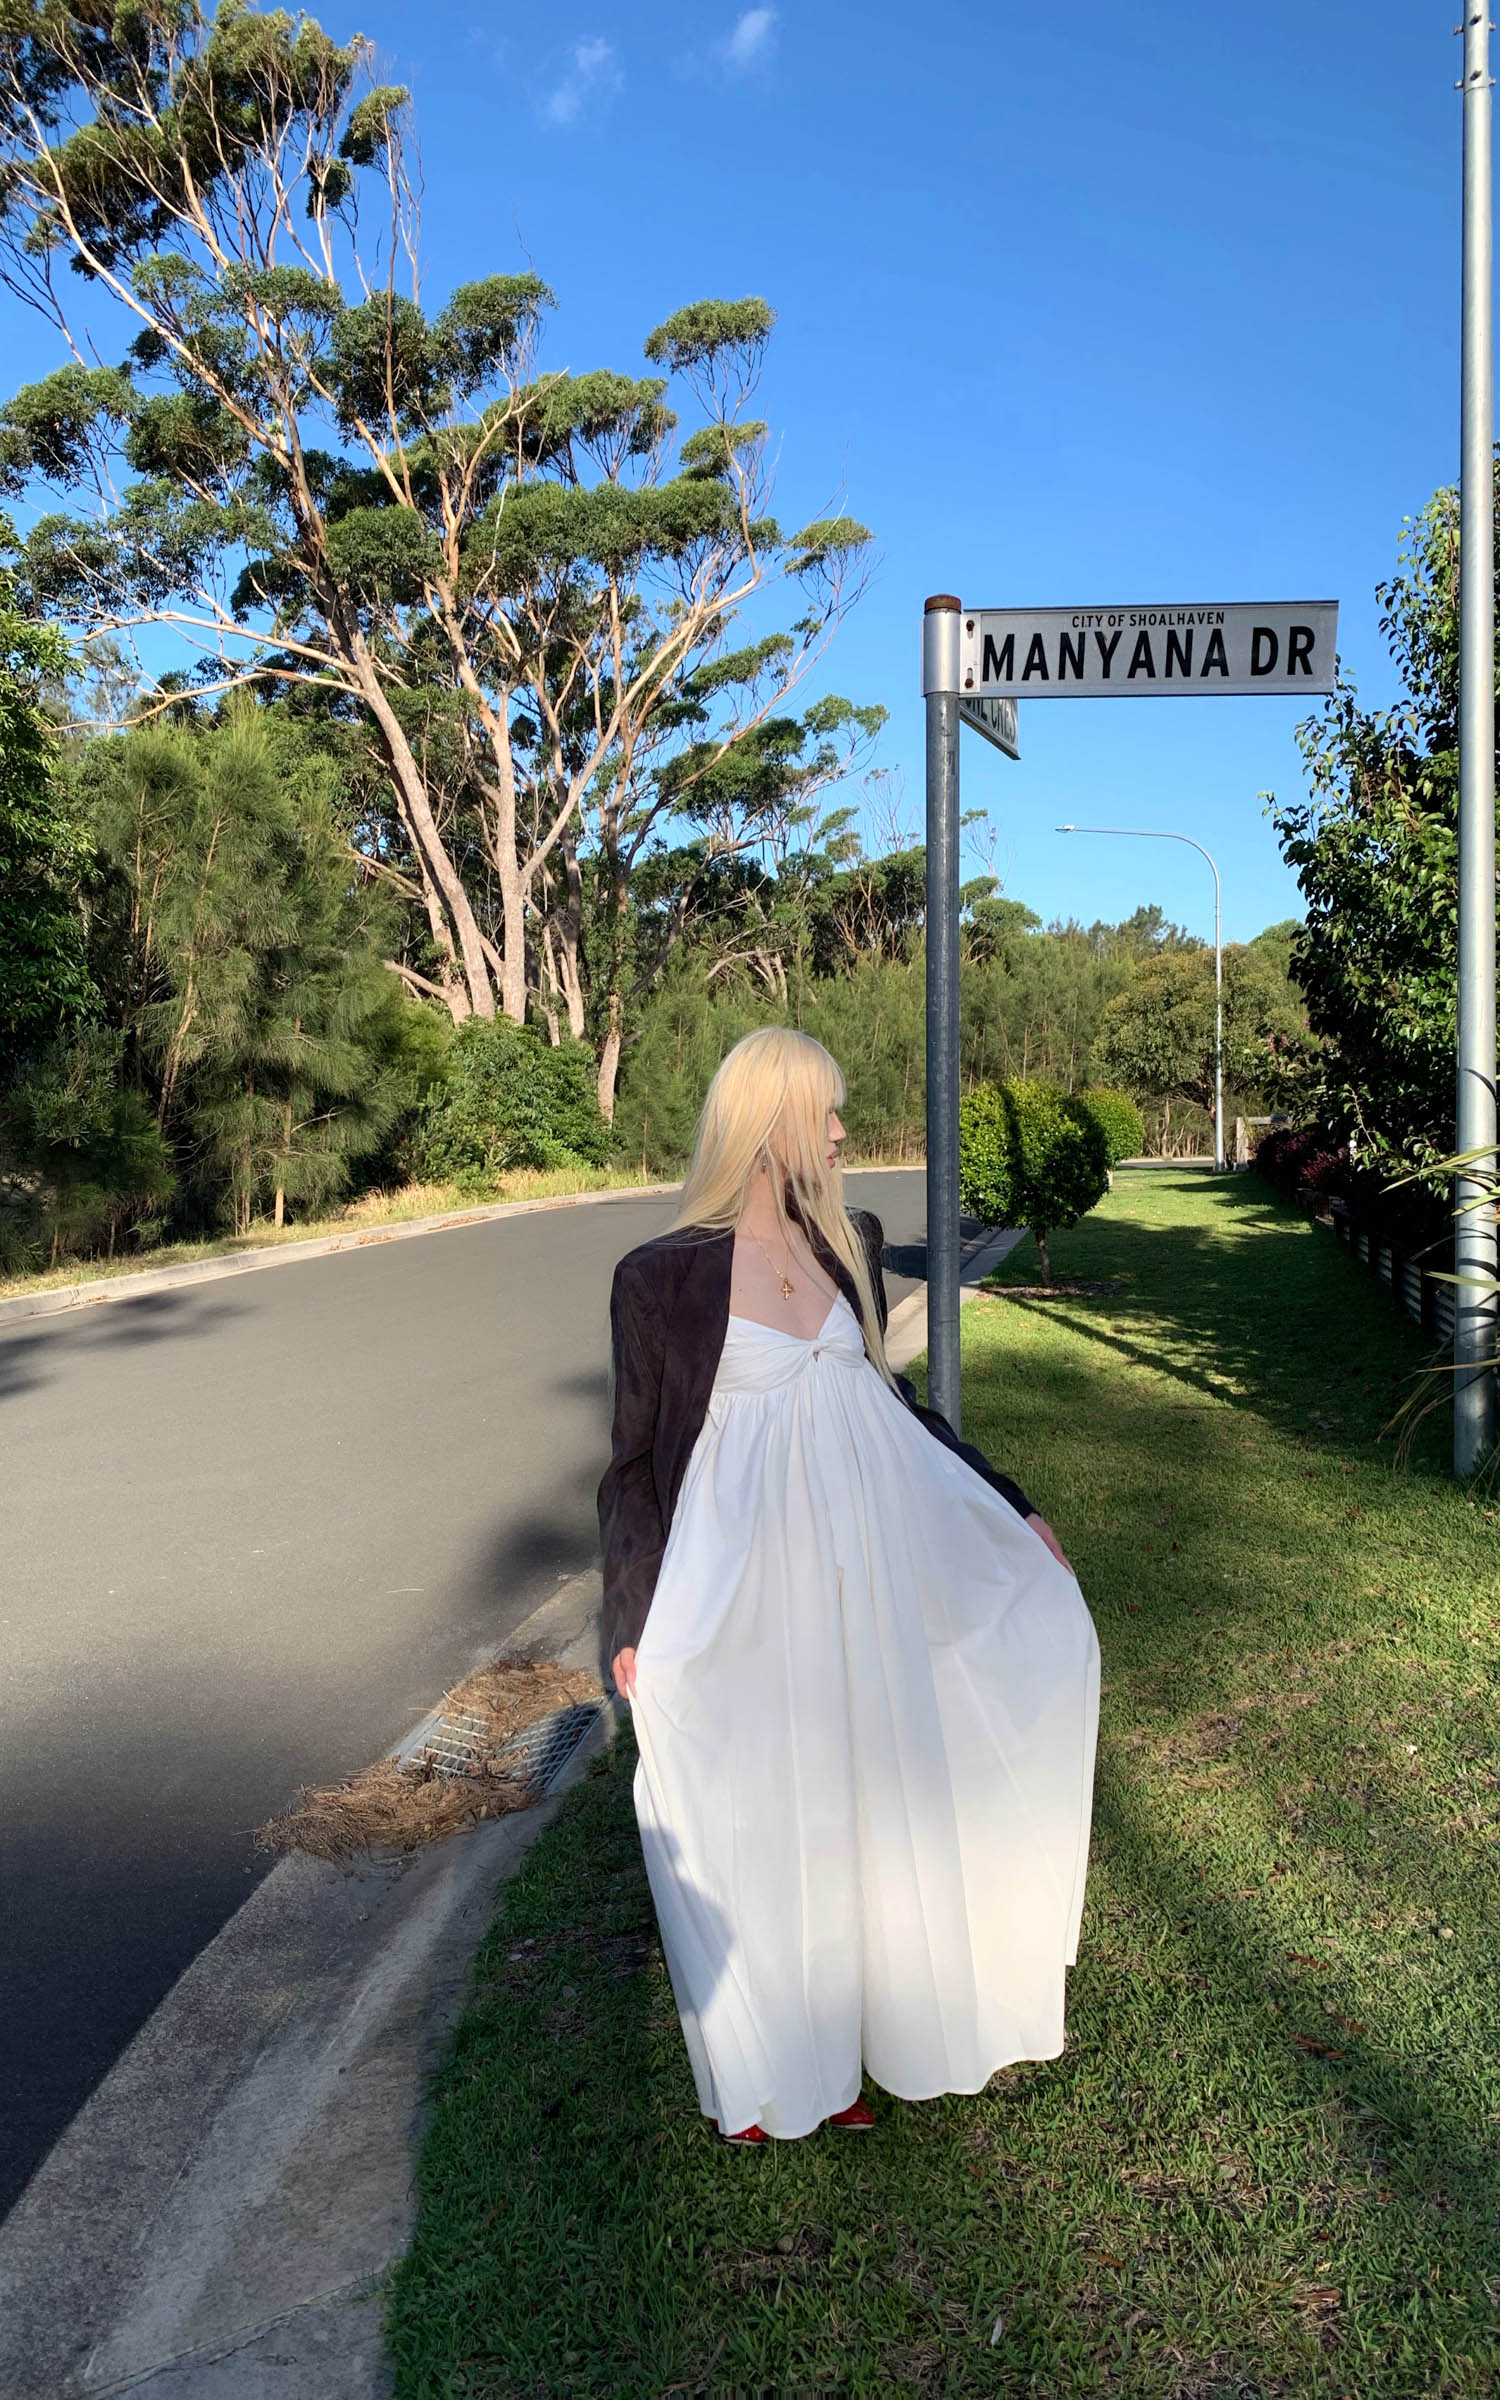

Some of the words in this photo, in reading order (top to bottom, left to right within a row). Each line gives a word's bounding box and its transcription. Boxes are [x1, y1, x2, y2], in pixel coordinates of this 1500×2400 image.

[1072, 615, 1103, 628] CITY
[1107, 614, 1125, 627] OF
[1129, 611, 1225, 627] SHOALHAVEN
[982, 628, 1229, 682] MANYANA
[1250, 626, 1315, 676] DR
